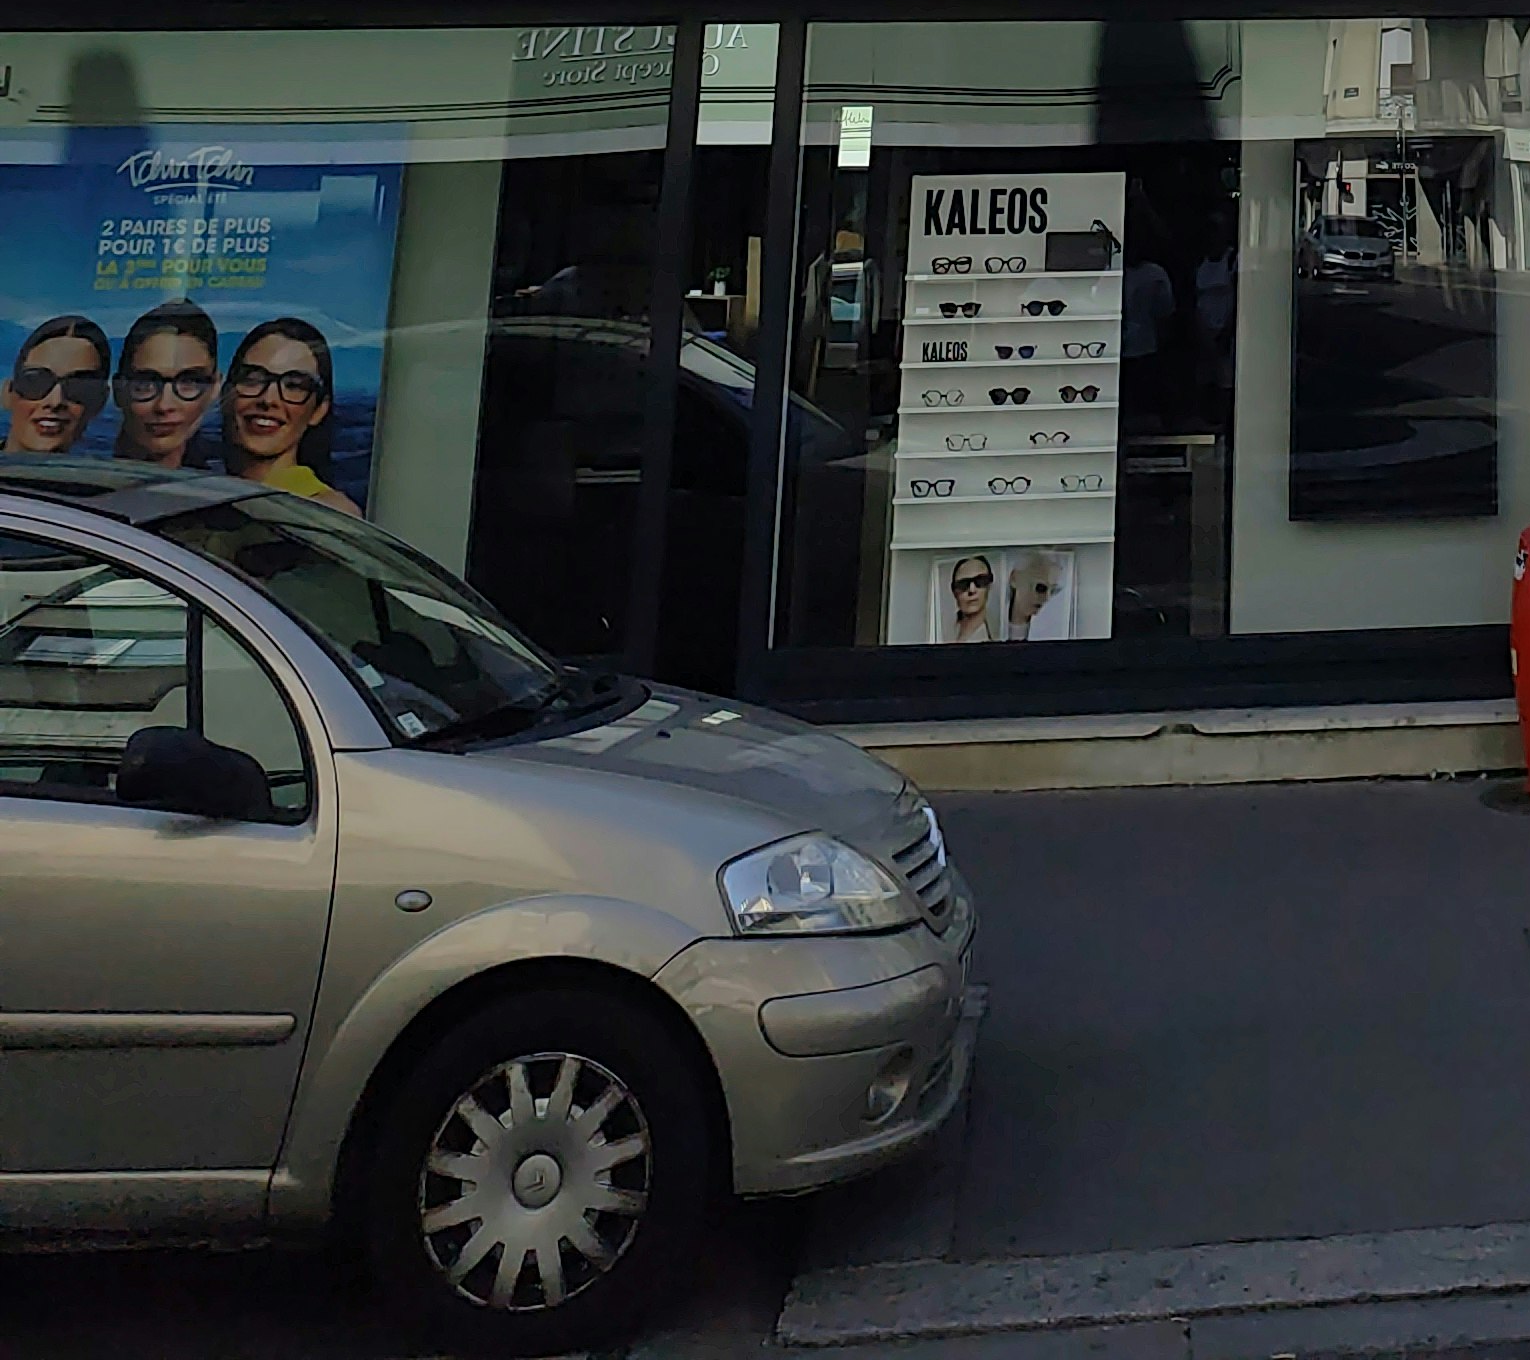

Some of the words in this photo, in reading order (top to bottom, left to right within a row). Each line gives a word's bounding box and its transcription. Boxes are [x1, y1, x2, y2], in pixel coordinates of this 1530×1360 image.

[923, 187, 1048, 236] KALEOS
[102, 220, 115, 236] 2
[120, 218, 187, 235] PAIRES
[194, 218, 219, 235] DE
[224, 217, 271, 234] PLUS
[98, 239, 155, 256] POUR
[191, 238, 216, 255] DE
[922, 341, 968, 363] KALEOS
